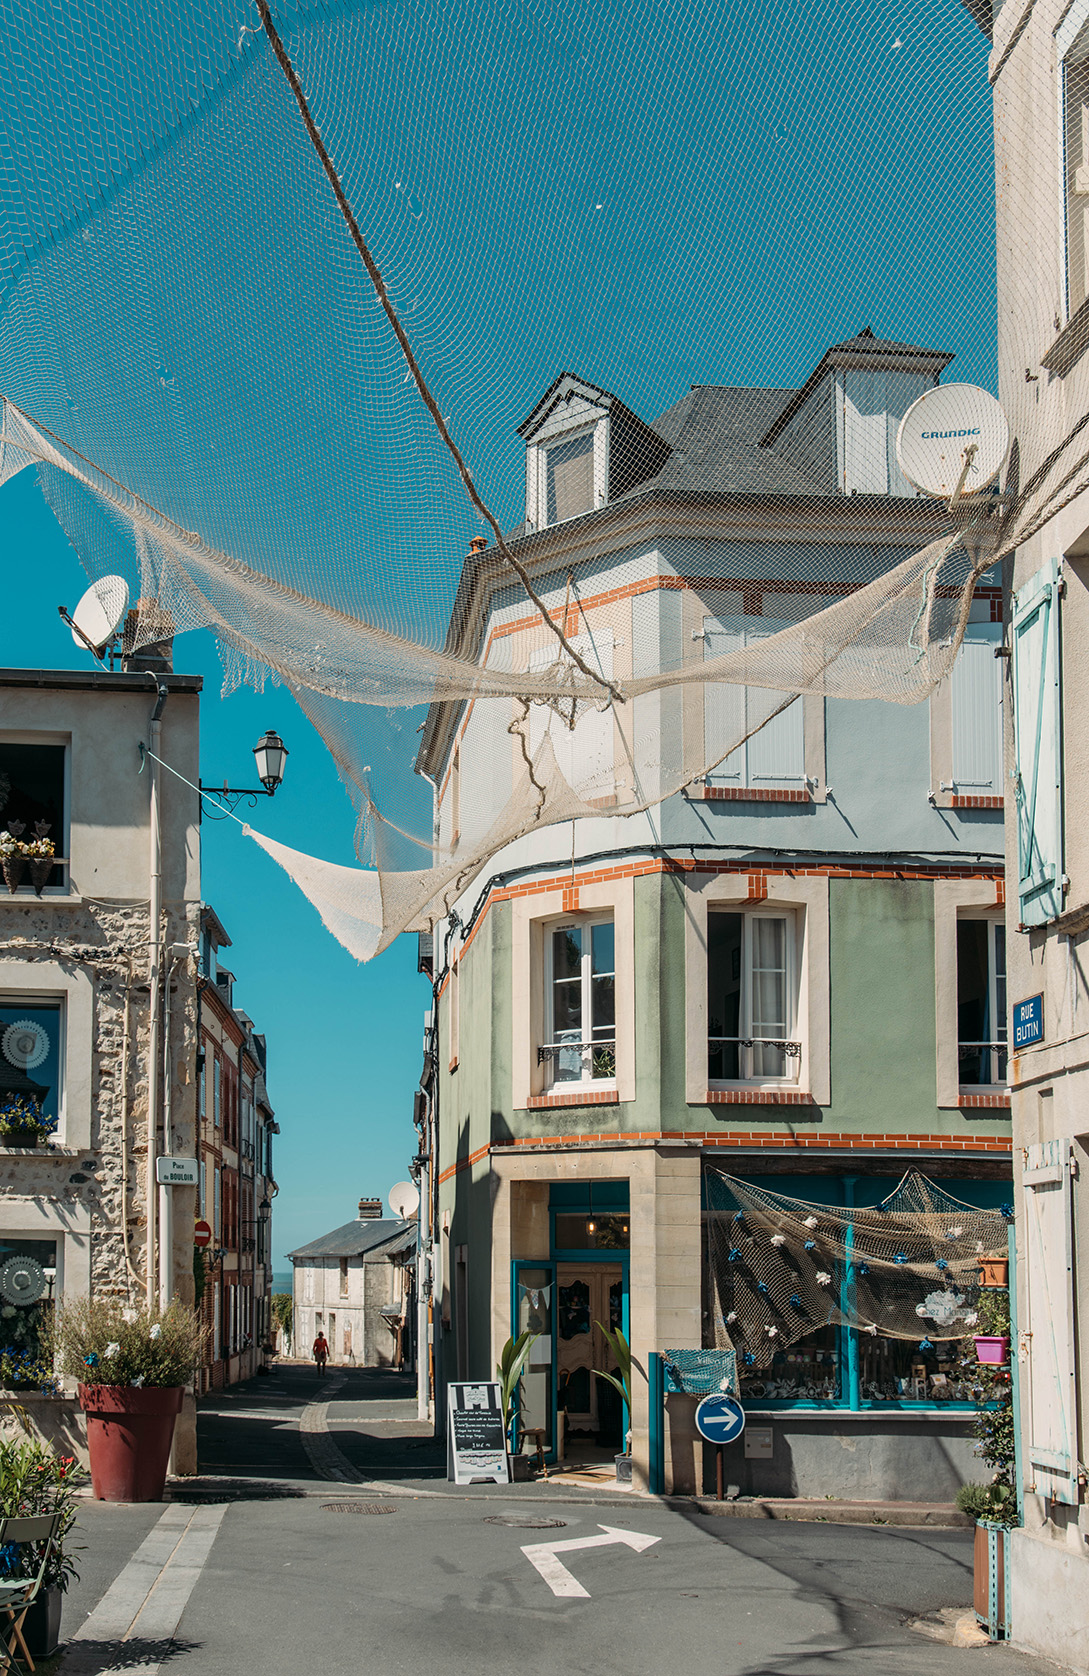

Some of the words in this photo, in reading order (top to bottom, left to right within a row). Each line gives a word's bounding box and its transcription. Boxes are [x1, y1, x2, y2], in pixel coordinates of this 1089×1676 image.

[921, 427, 980, 439] GRUNDIG
[1020, 1002, 1034, 1021] RUE
[1016, 1020, 1039, 1042] BUTIN
[170, 1172, 193, 1181] BOULOIR
